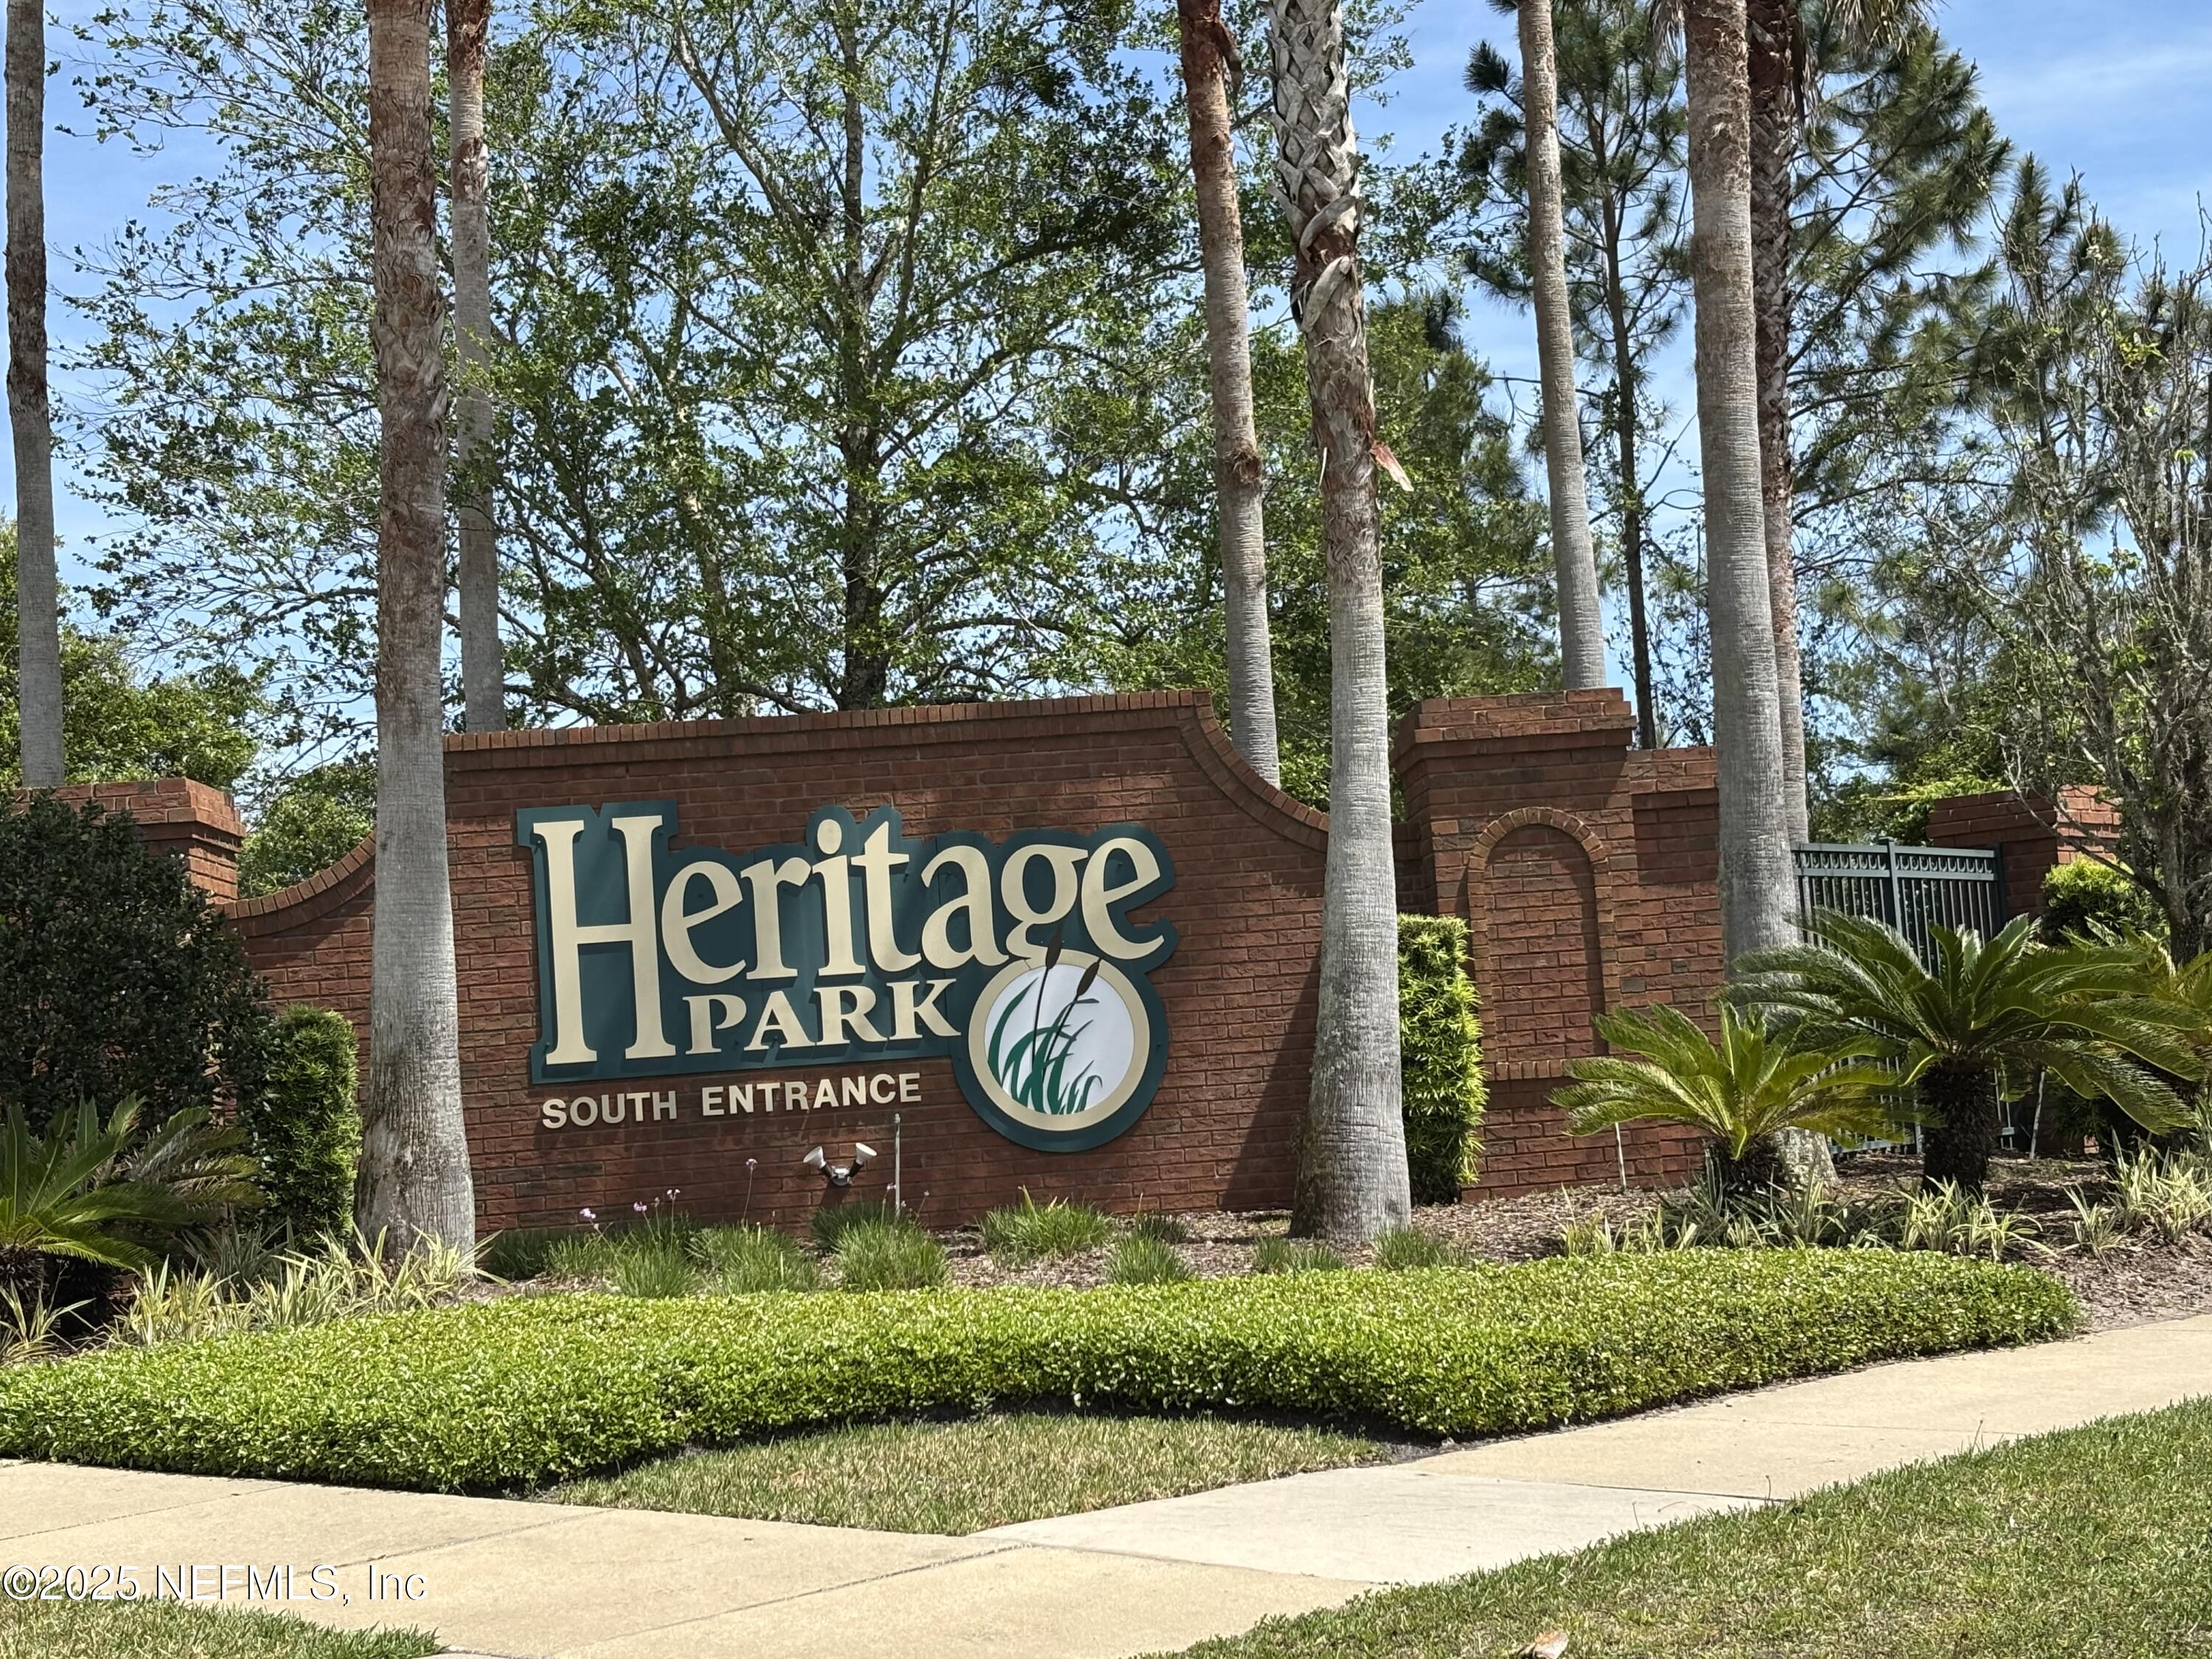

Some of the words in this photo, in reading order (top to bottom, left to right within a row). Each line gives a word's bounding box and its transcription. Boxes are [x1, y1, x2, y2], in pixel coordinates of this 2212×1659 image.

[532, 814, 1165, 1065] Heritage
[682, 978, 962, 1055] PARK
[542, 1090, 678, 1130] SOUTH
[701, 1072, 922, 1117] ENTRANCE
